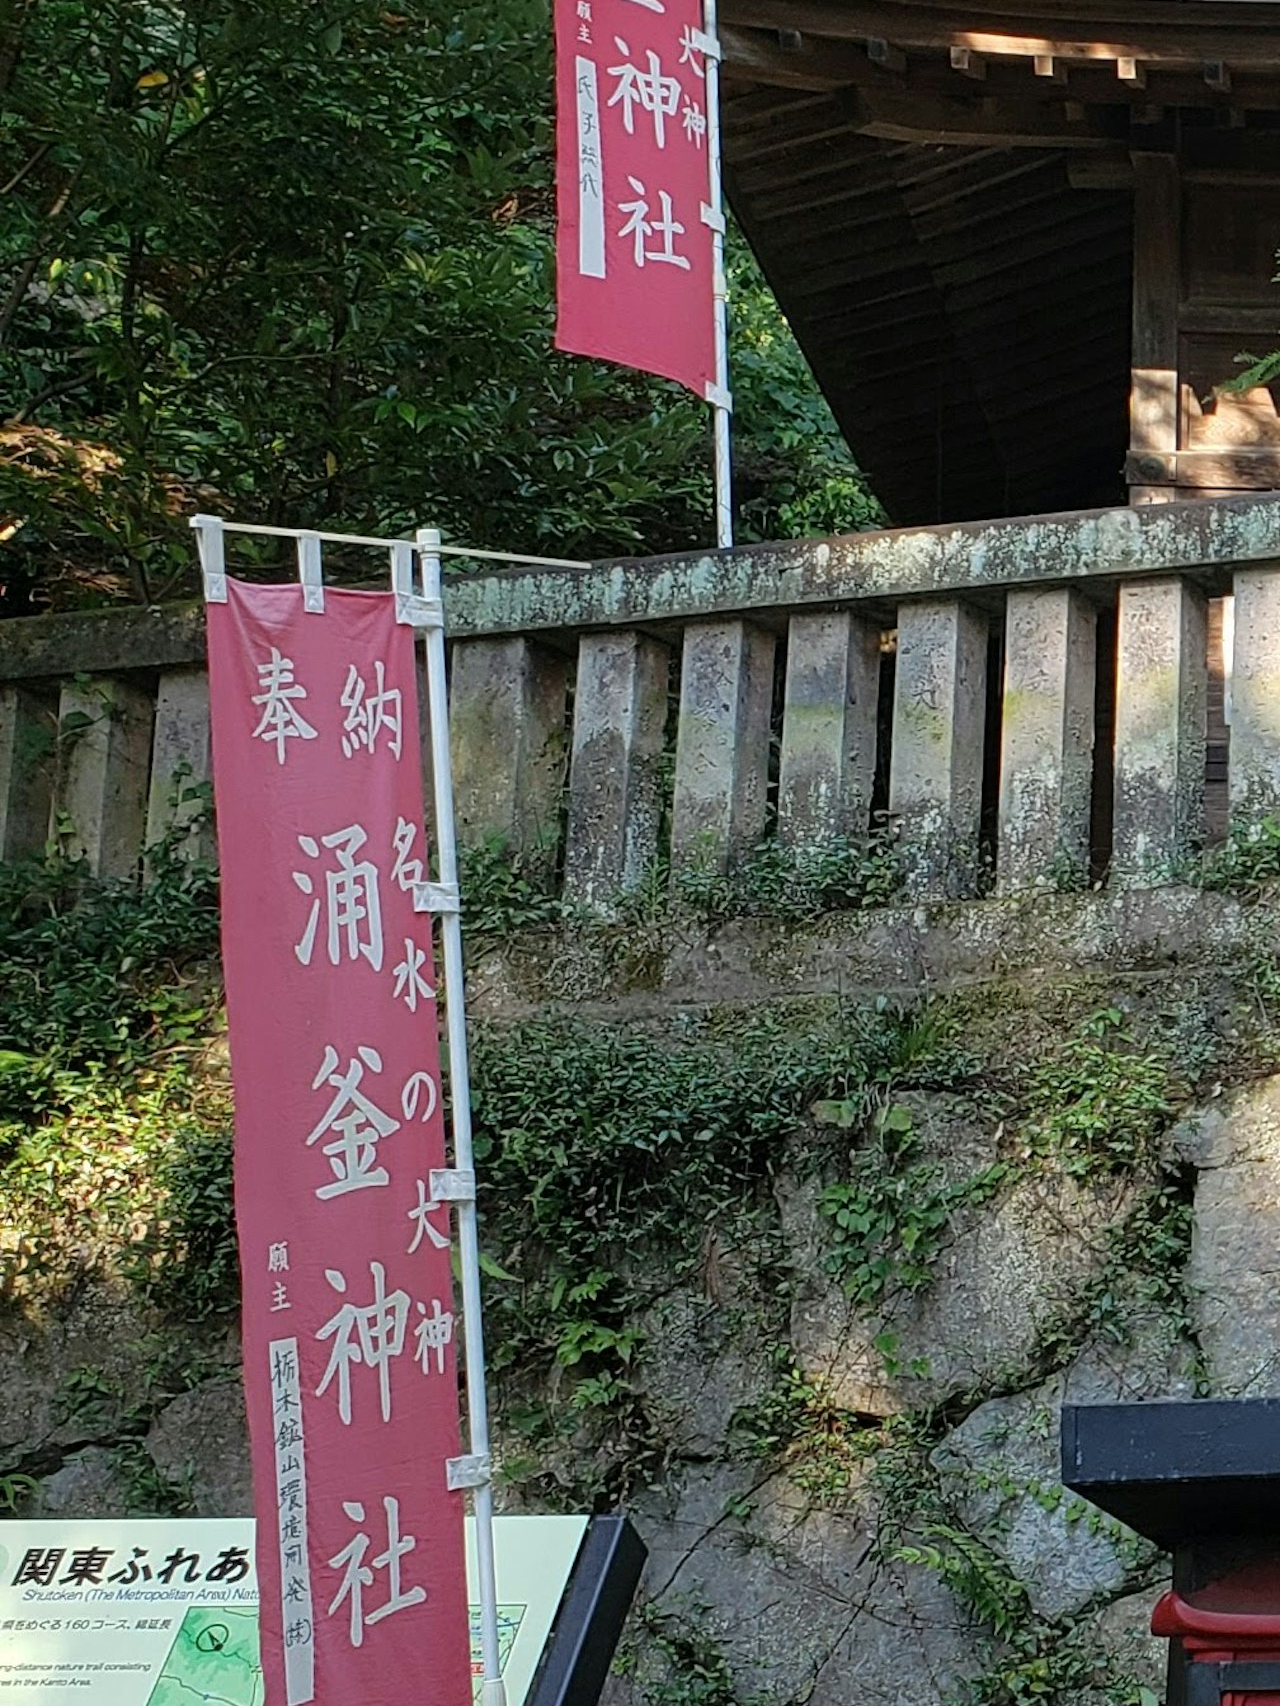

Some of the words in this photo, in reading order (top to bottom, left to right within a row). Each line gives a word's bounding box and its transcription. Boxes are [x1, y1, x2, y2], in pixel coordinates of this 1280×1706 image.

[251, 647, 403, 765] 奉納
[293, 823, 428, 1648] 涌釜神社
[268, 1240, 291, 1313] 願主
[11, 1546, 251, 1587] 関東ふれあ
[22, 1588, 83, 1602] Shutoken
[84, 1588, 114, 1602] (The
[115, 1588, 194, 1602] Metropolitan
